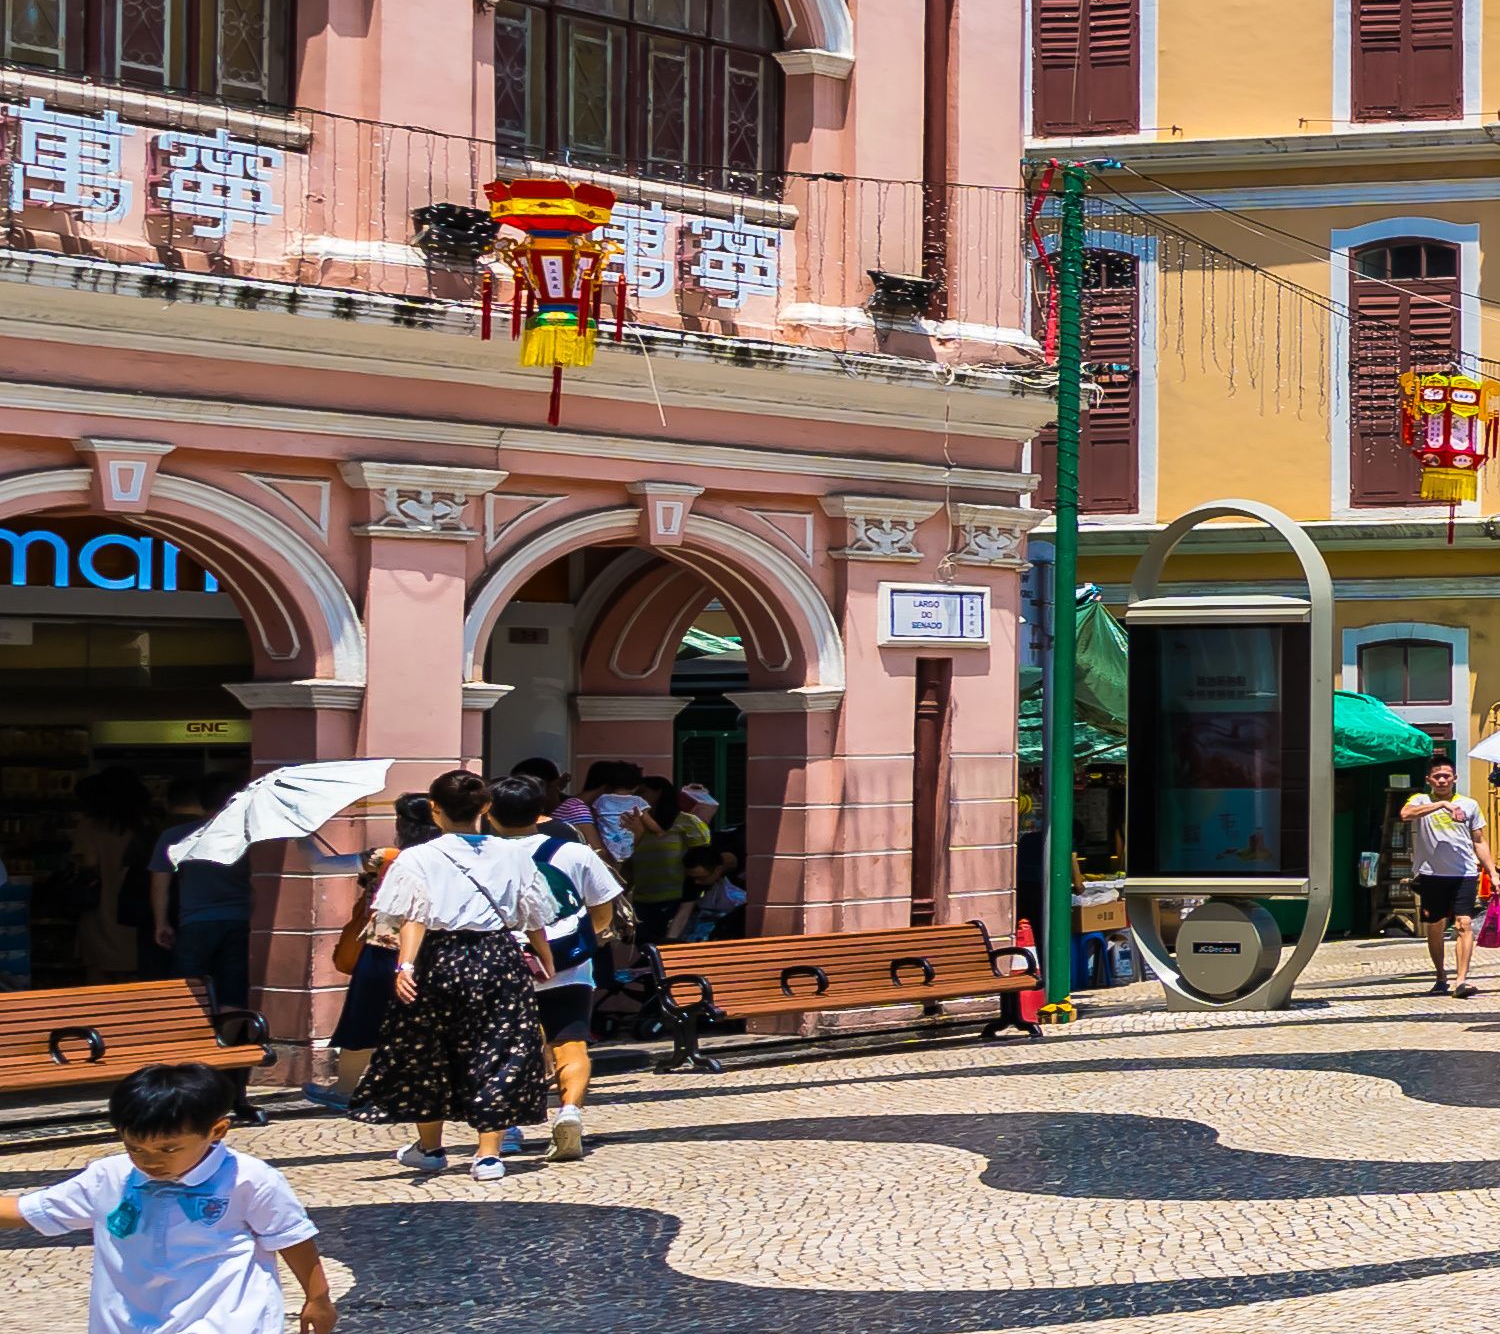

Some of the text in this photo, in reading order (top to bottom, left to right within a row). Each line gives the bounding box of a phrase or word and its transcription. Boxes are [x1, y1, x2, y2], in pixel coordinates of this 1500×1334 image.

[8, 96, 284, 239] 萬寧
[913, 600, 940, 609] LARGO
[921, 611, 932, 619] DO
[911, 621, 943, 630] SENADO
[186, 722, 229, 733] GNC
